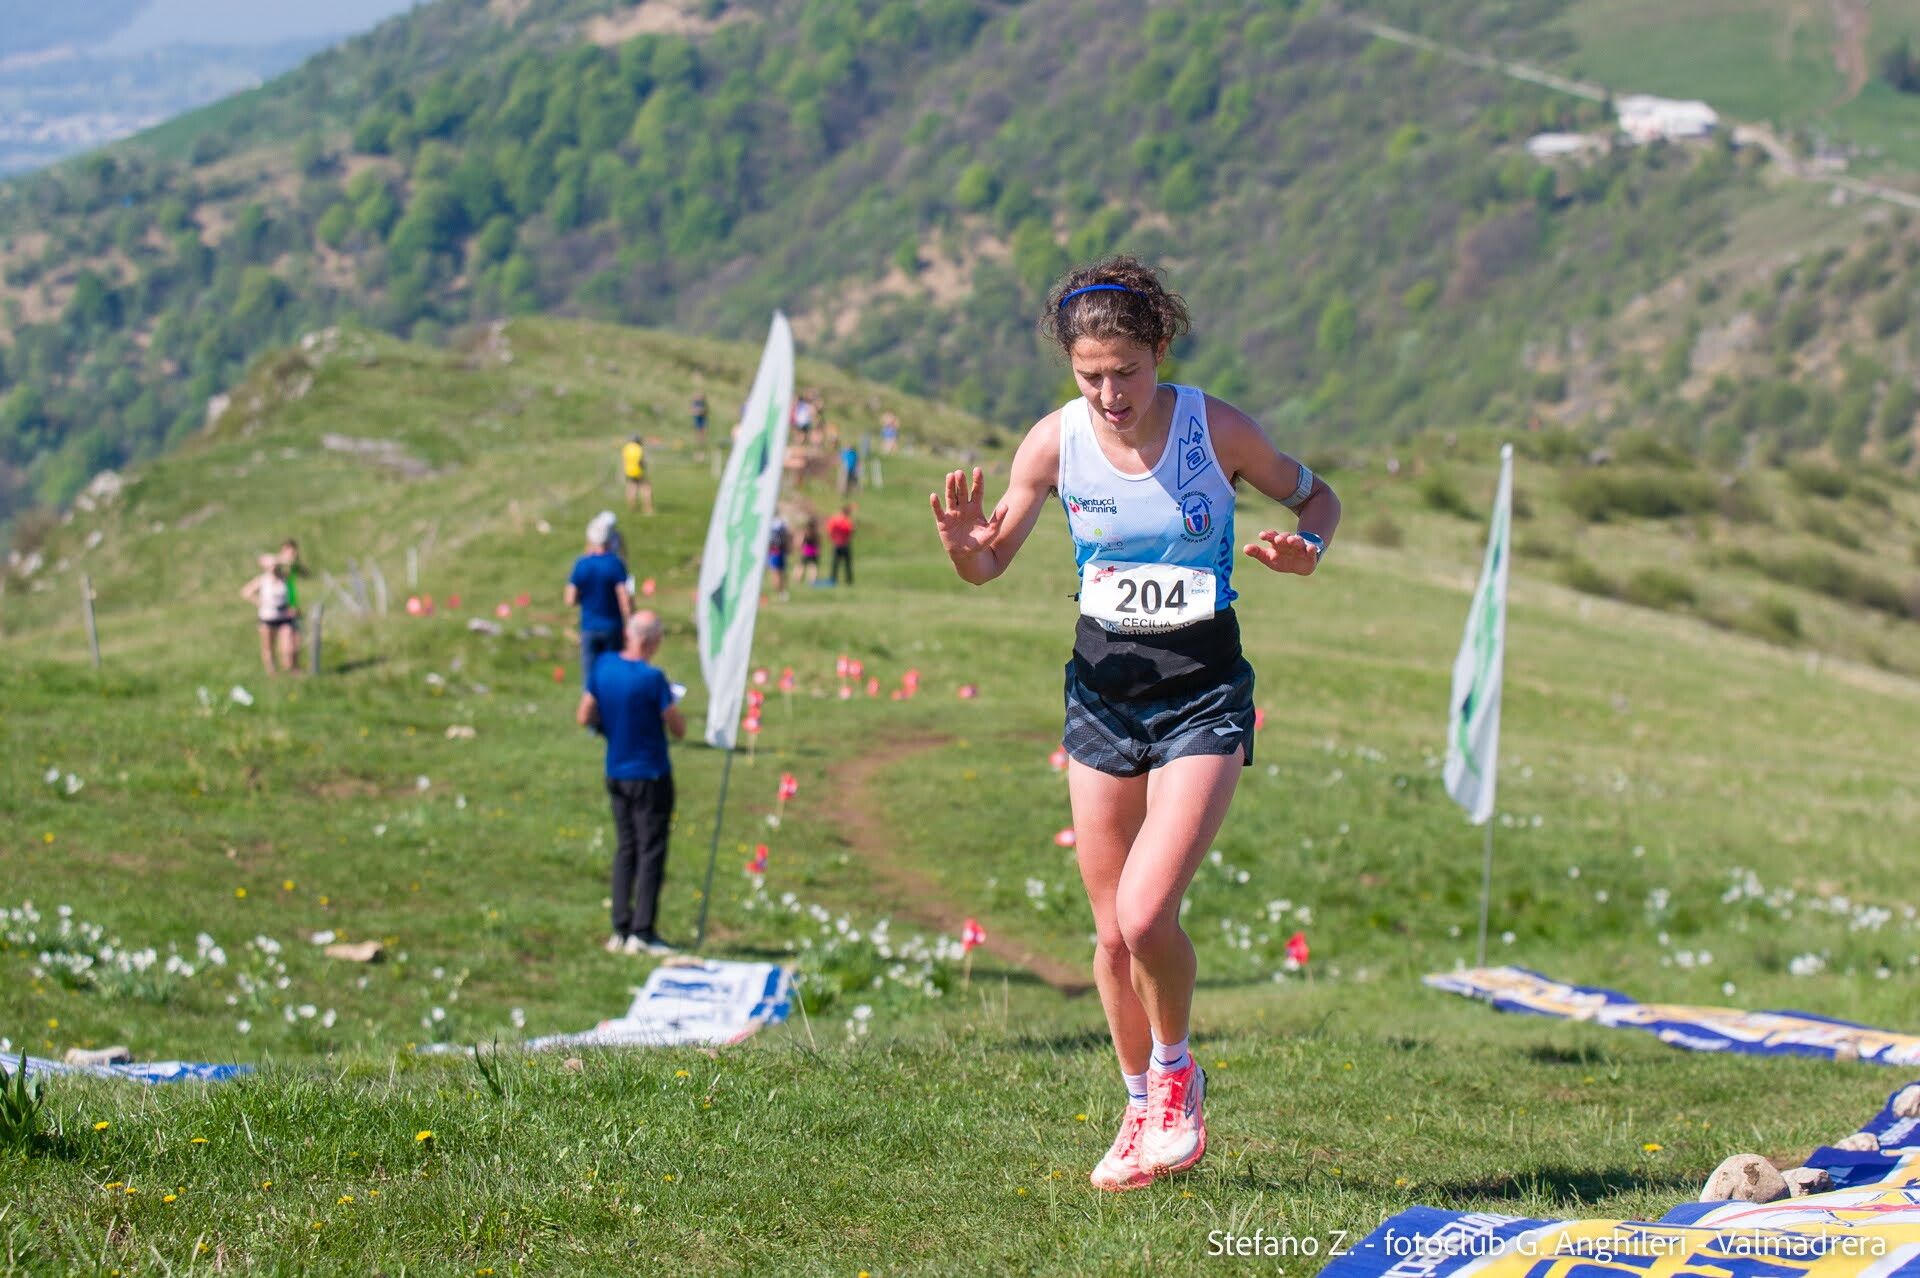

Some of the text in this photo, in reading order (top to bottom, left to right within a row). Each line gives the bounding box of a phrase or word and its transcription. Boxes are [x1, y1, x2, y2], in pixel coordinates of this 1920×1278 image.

[1078, 497, 1115, 506] Santucci
[1082, 502, 1118, 515] Running
[1115, 578, 1189, 616] 204
[1122, 617, 1173, 629] CECILIA
